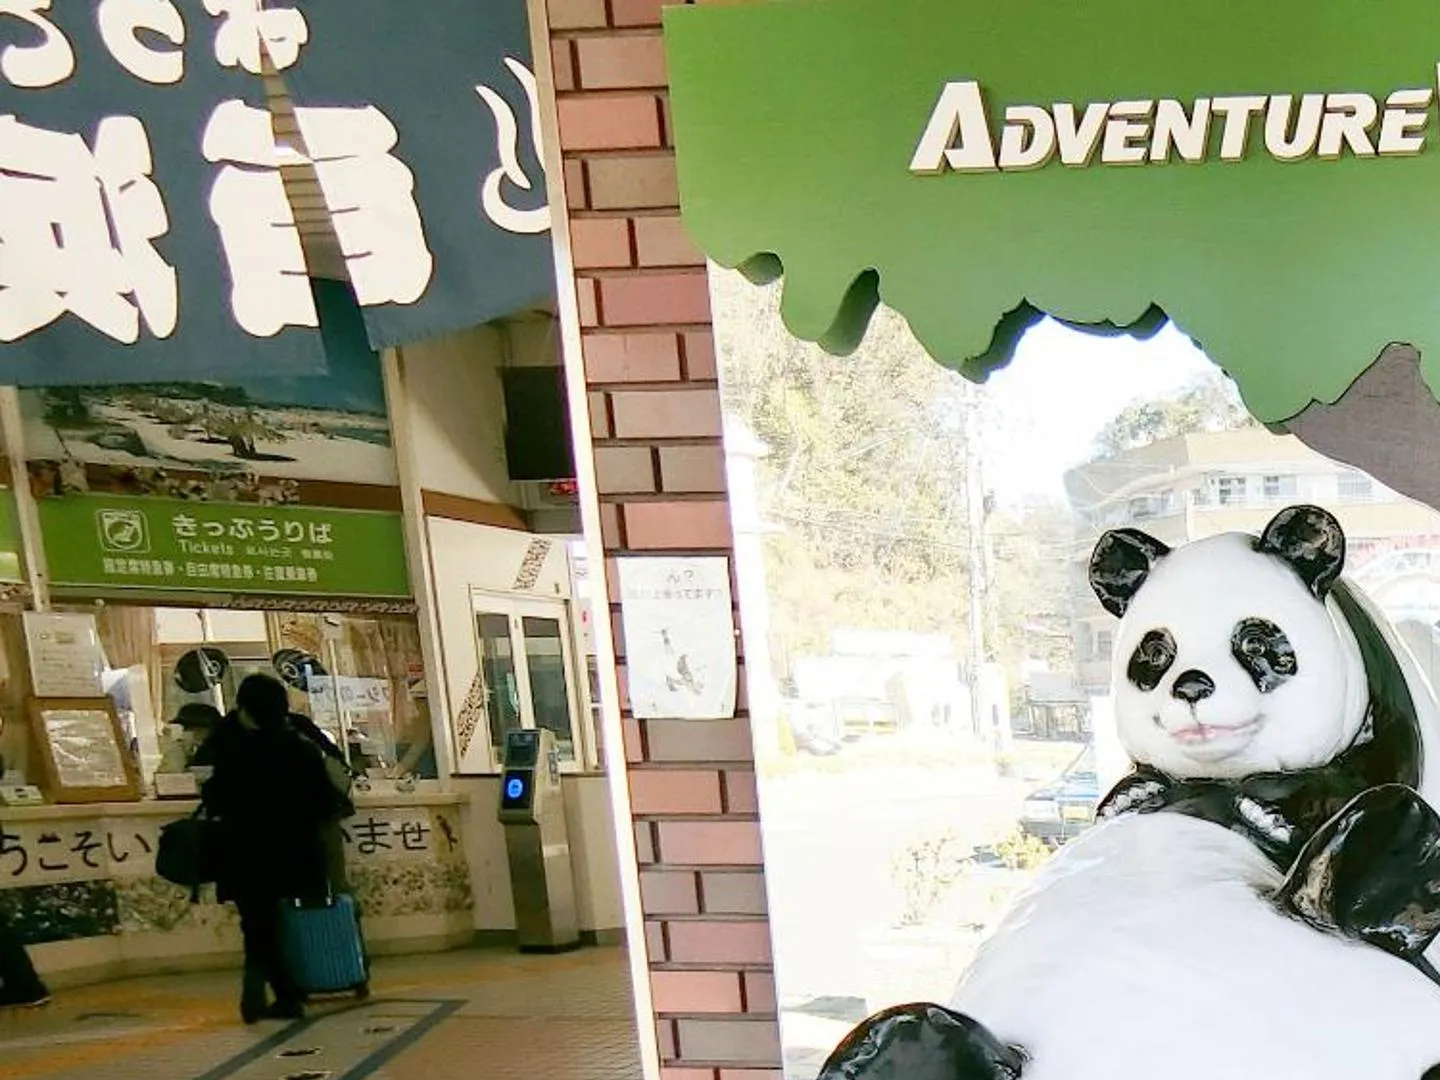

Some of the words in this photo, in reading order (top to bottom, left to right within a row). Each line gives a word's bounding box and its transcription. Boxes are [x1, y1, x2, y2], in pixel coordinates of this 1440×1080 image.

[171, 513, 333, 543] きっぷうりば
[177, 539, 234, 555] Tickets
